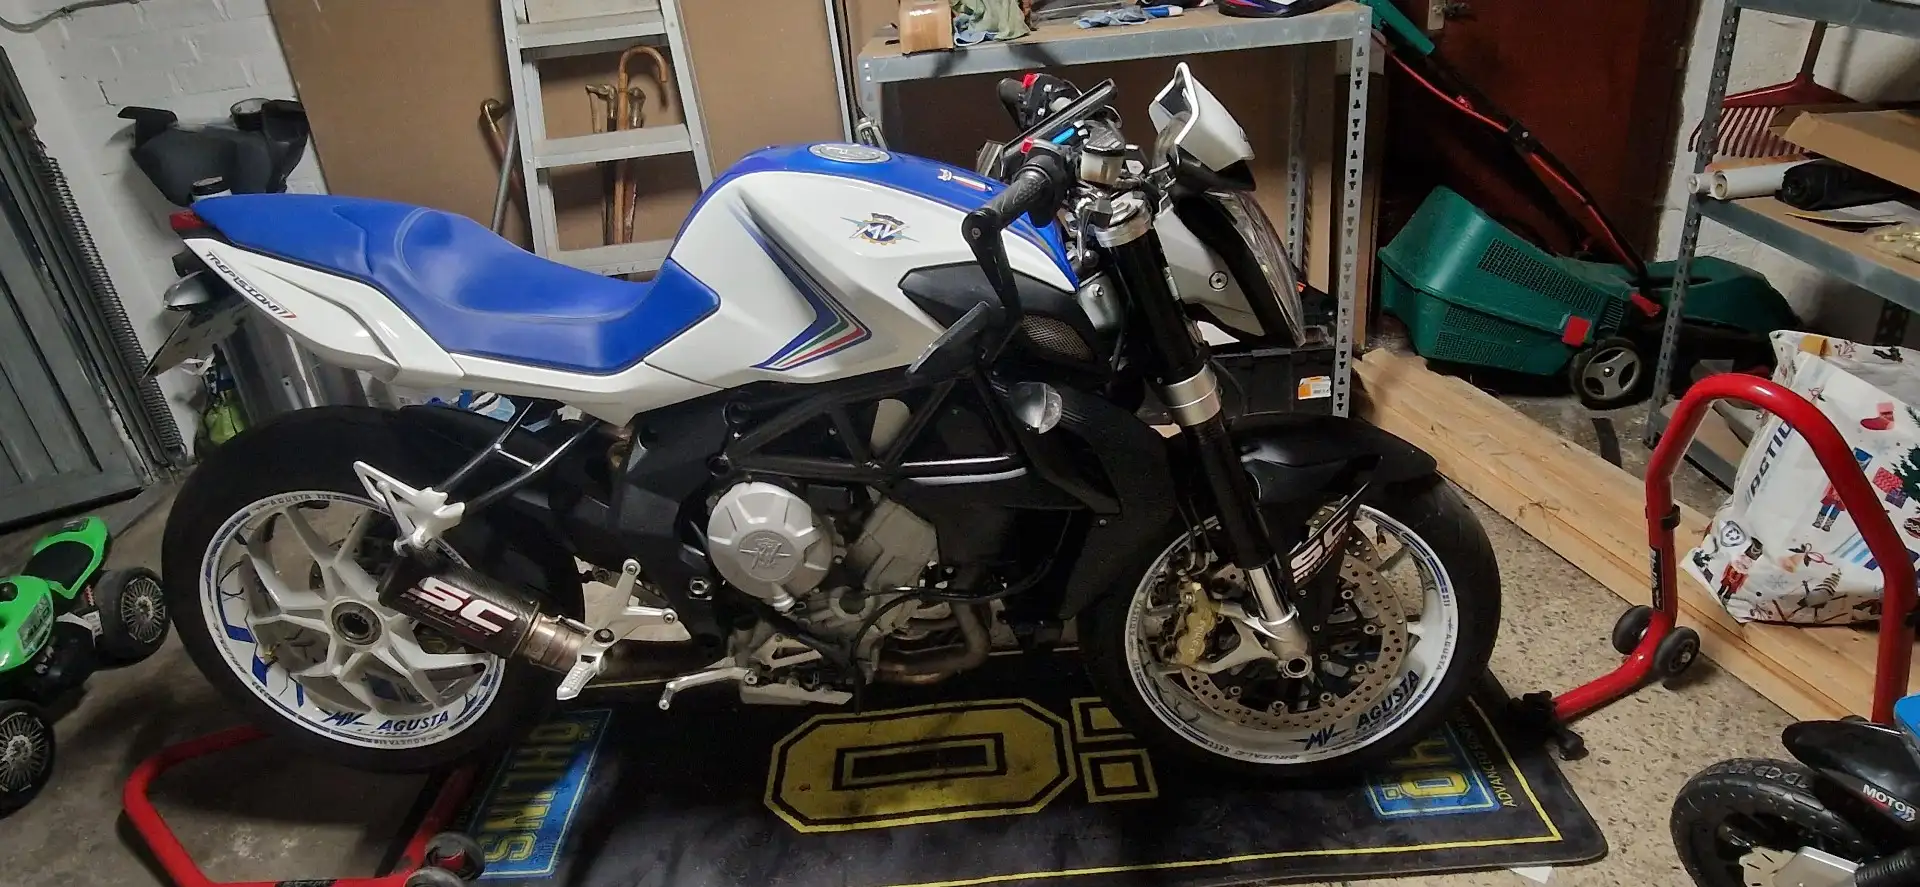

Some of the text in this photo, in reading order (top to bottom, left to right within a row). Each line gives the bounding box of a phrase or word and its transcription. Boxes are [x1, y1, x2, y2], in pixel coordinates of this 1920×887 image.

[1750, 419, 1793, 498] ACTIO
[1290, 511, 1348, 577] SC
[407, 576, 517, 633] SC
[320, 710, 449, 732] MV AGUSTA
[1303, 723, 1337, 751] MV
[1356, 670, 1420, 730] AGUSTA
